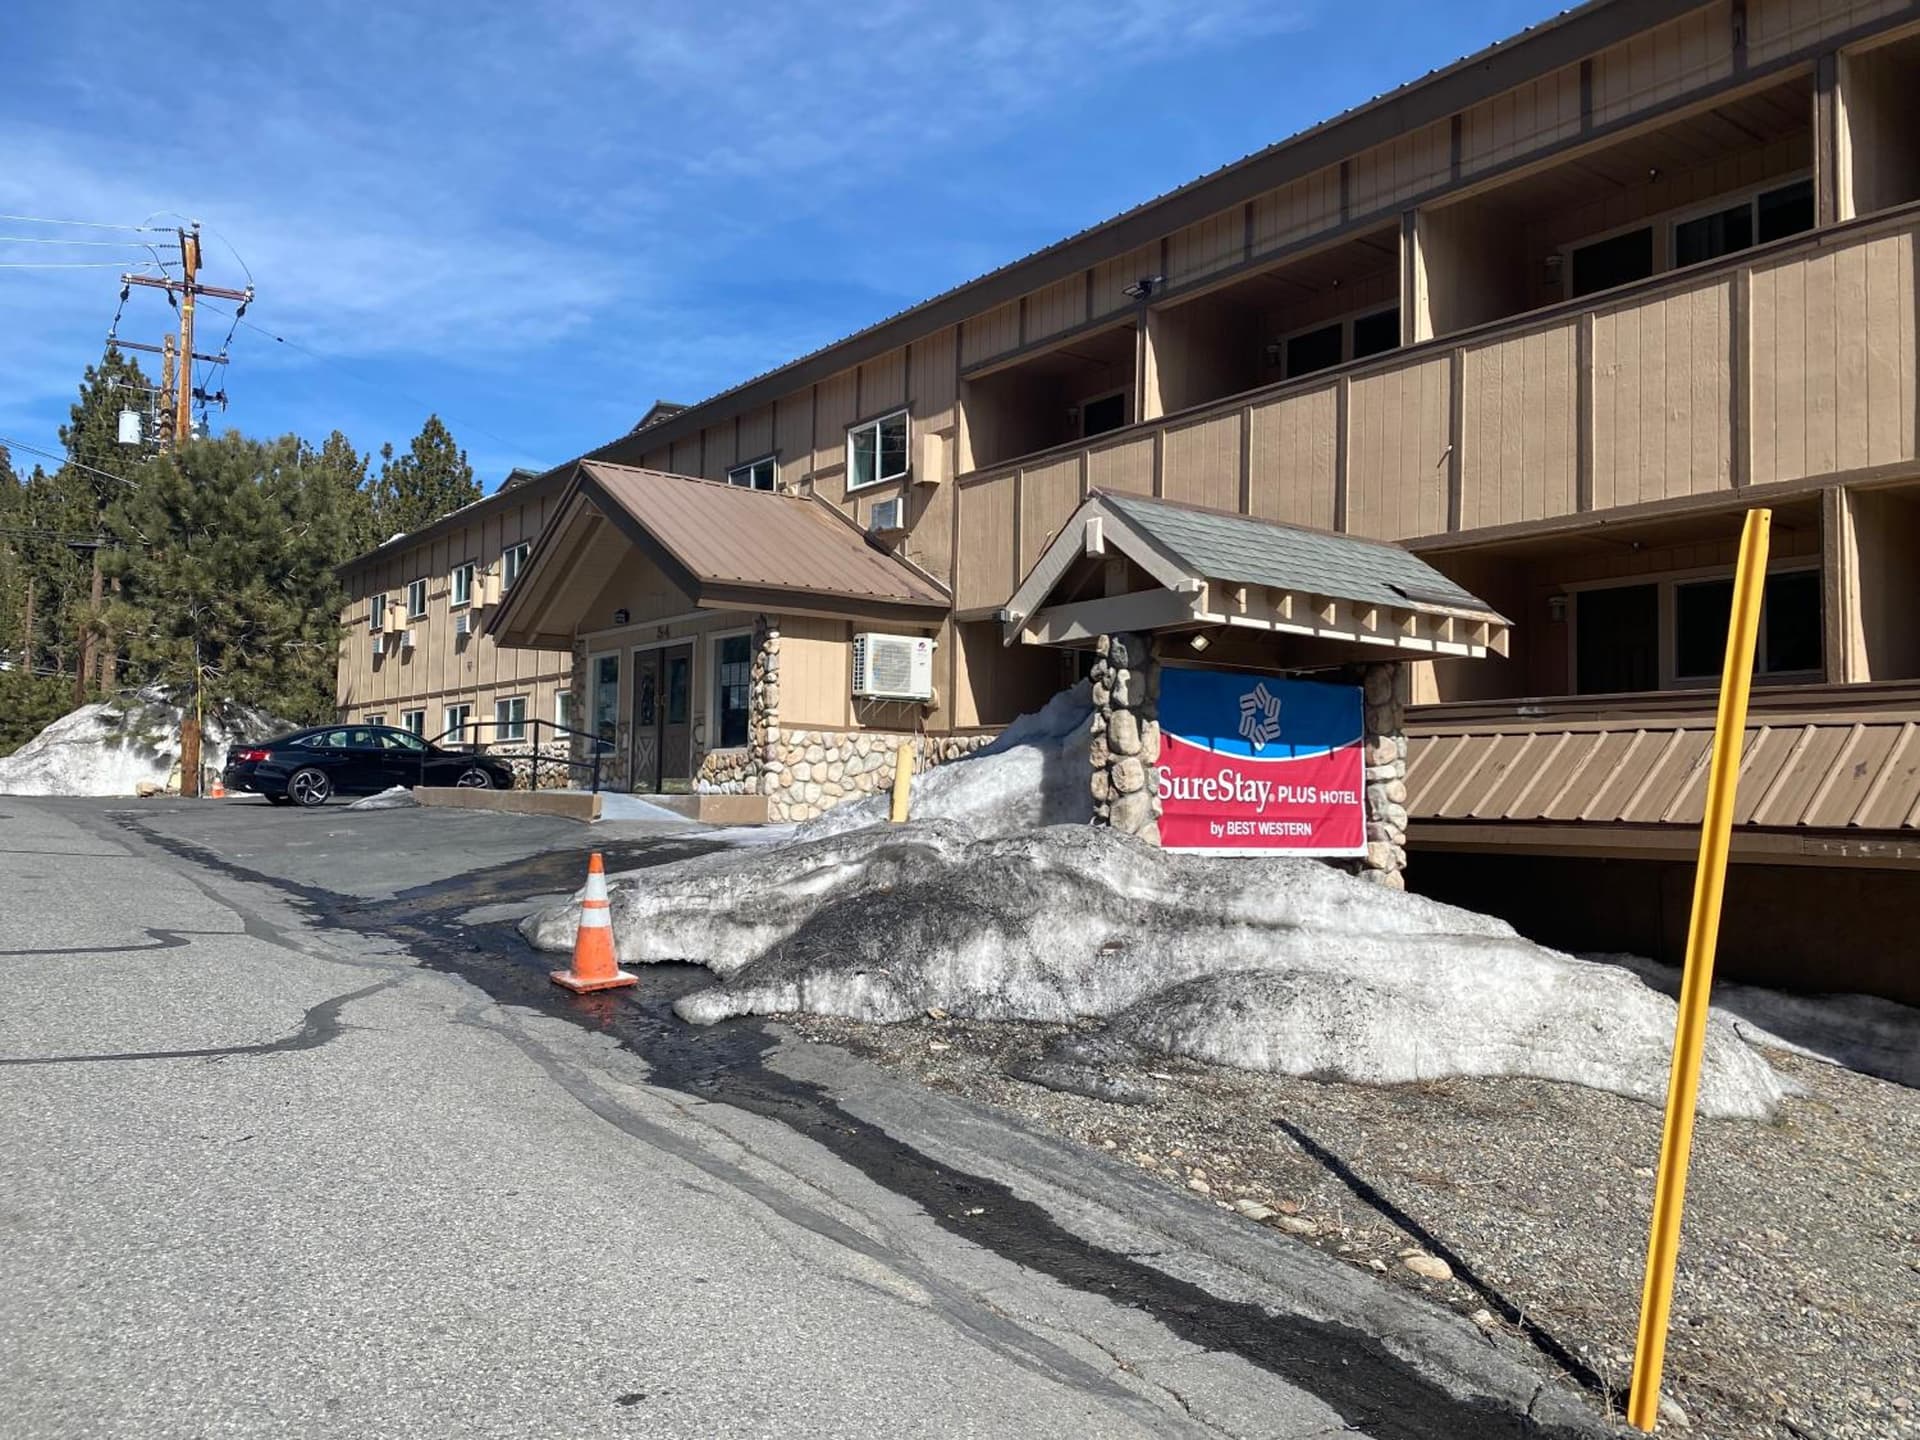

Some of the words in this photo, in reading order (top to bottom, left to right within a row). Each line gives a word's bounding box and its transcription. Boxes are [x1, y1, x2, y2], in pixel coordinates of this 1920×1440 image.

[1157, 765, 1270, 813] SureStay
[1278, 786, 1316, 804] PLUS
[1320, 791, 1358, 804] HOTEL
[1210, 822, 1224, 838] by
[1227, 821, 1256, 835] BEST
[1258, 823, 1312, 836] WESTERN
